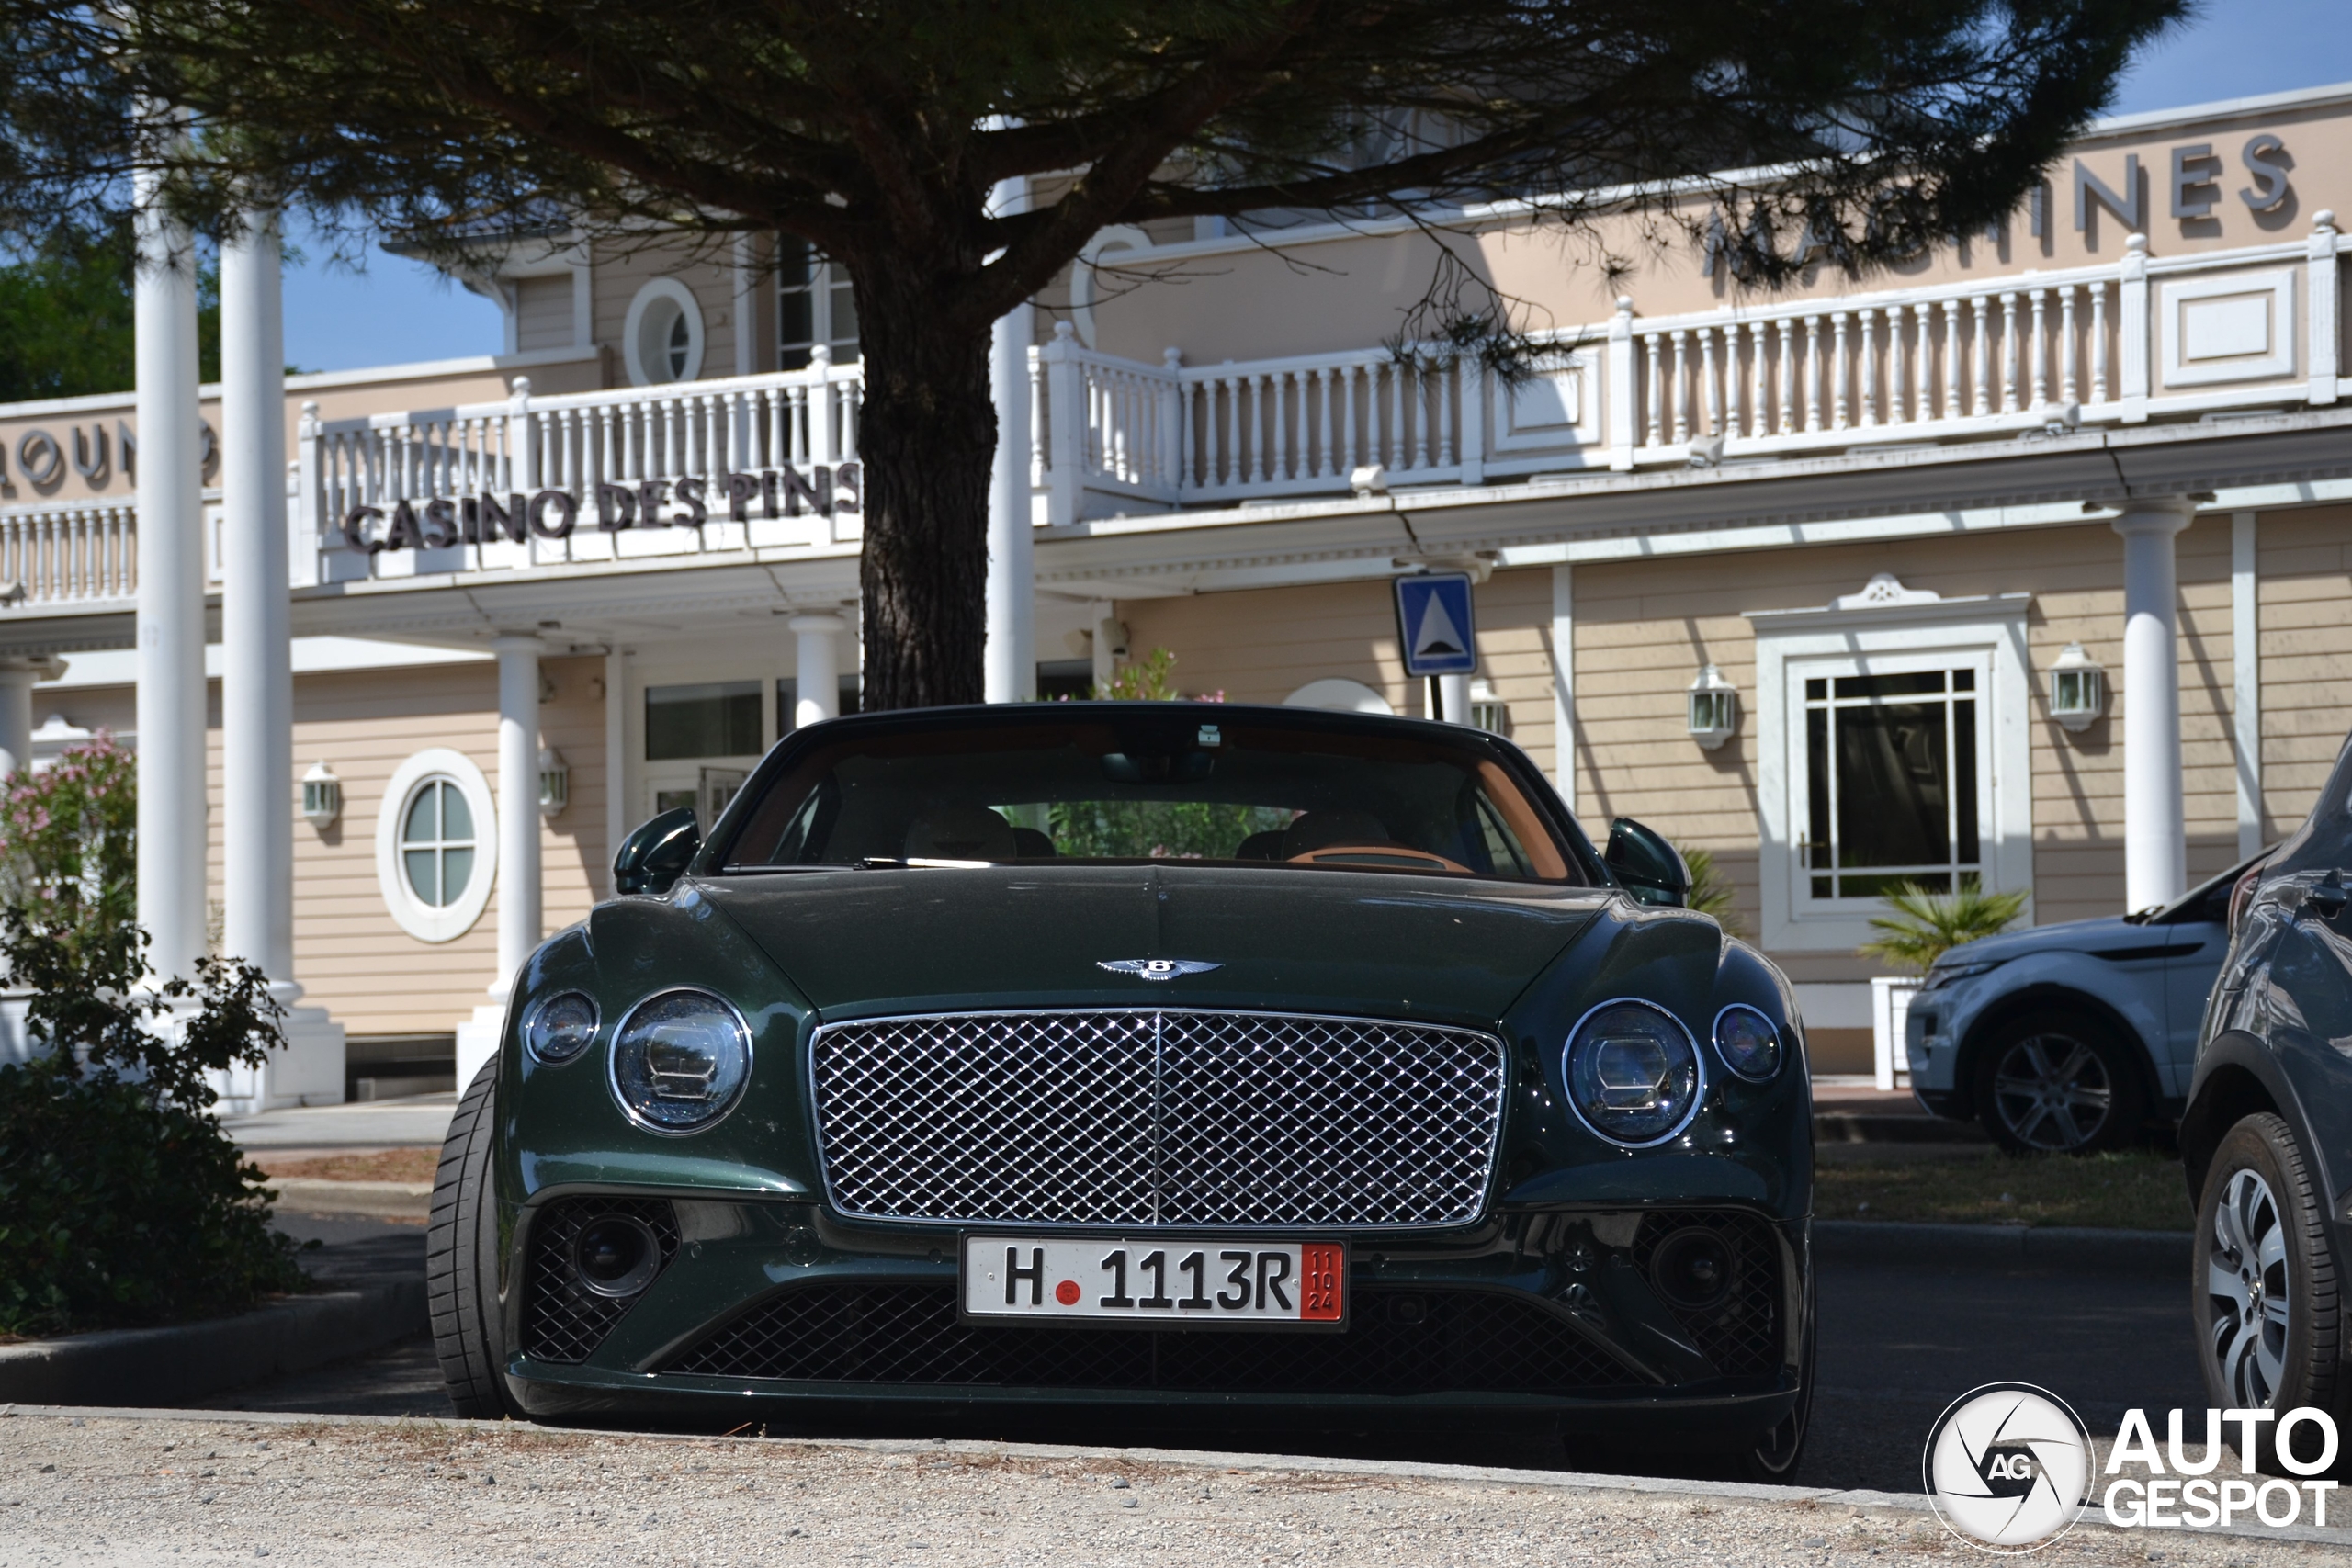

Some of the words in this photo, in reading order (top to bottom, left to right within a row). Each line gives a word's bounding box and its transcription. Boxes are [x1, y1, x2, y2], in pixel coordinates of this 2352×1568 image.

[345, 490, 577, 553] CASINO
[596, 476, 707, 533] DES
[728, 461, 861, 522] PINS
[1311, 1251, 1333, 1269] 11
[1004, 1246, 1044, 1305] H
[1098, 1249, 1293, 1310] 1113R
[1310, 1271, 1333, 1290] 10
[1308, 1292, 1333, 1311] 24
